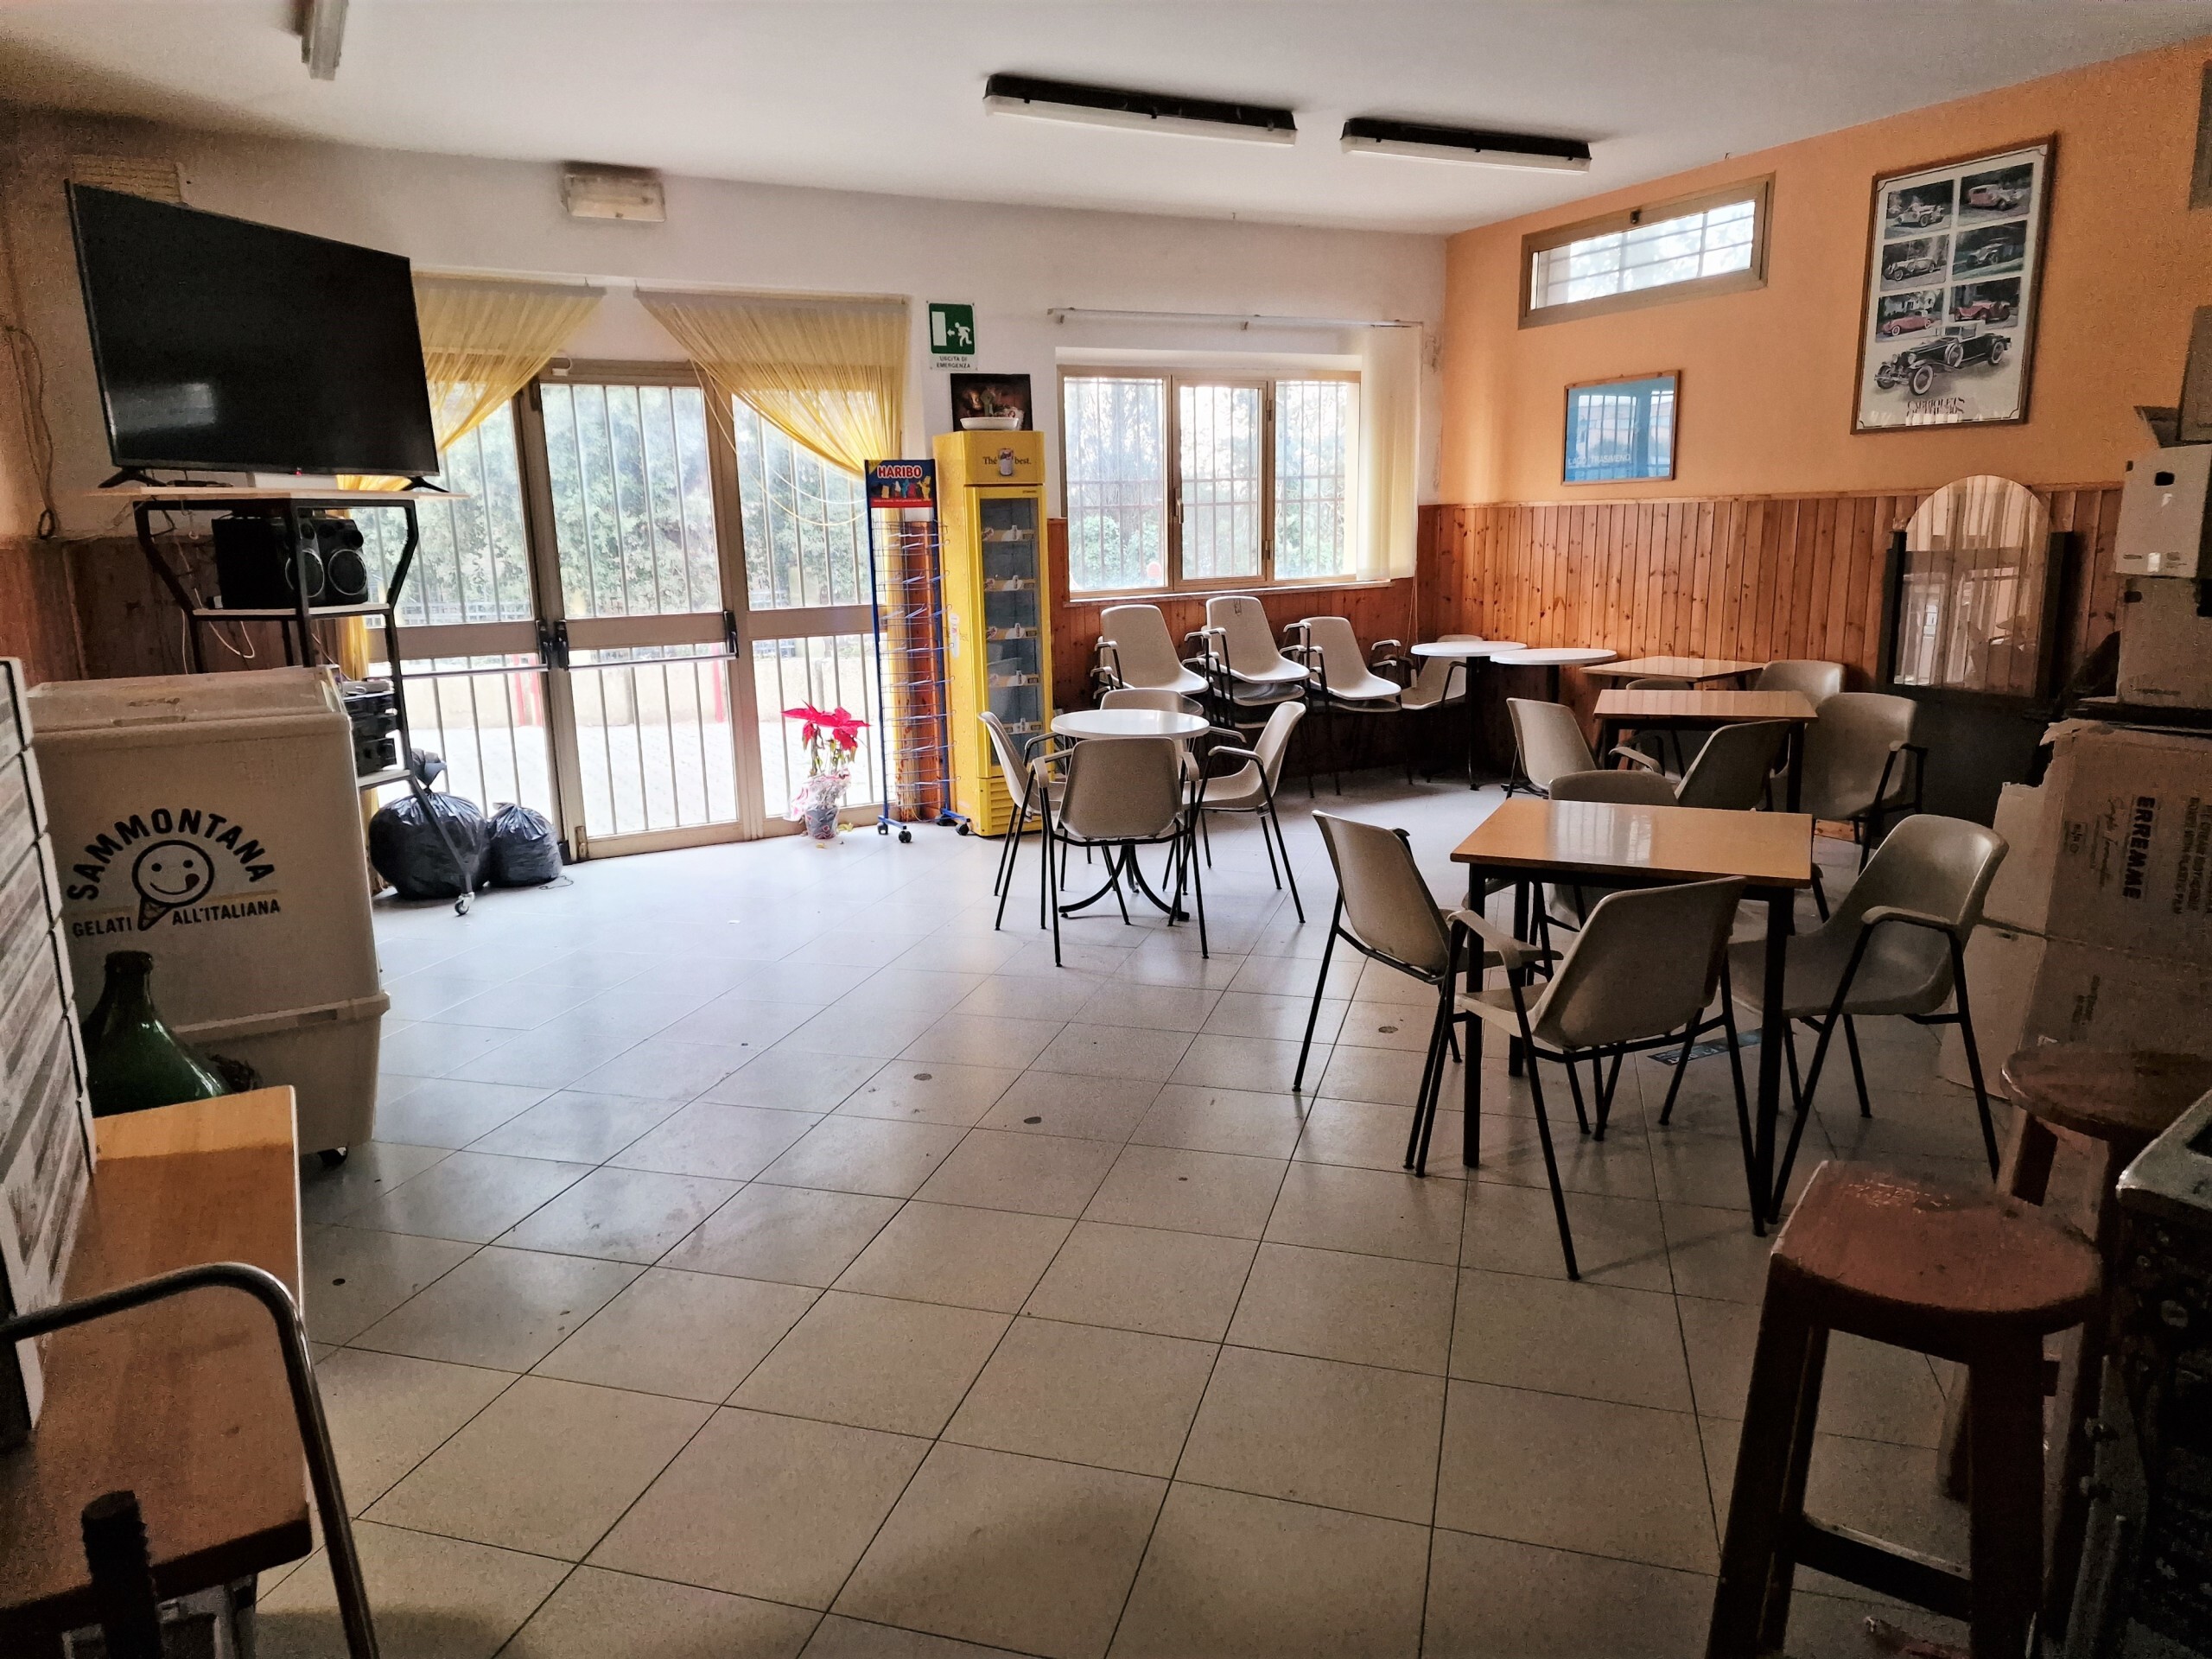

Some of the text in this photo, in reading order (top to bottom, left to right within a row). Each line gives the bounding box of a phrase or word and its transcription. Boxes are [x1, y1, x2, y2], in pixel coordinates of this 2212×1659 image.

[877, 465, 923, 479] HARIBO
[982, 455, 997, 465] Thé
[1567, 454, 1631, 466] LAGO TRASIMENO
[67, 808, 275, 900] SAMMONTANA
[2122, 796, 2156, 899] ERREMME
[73, 899, 281, 938] GELATI ALL'ITALIANA
